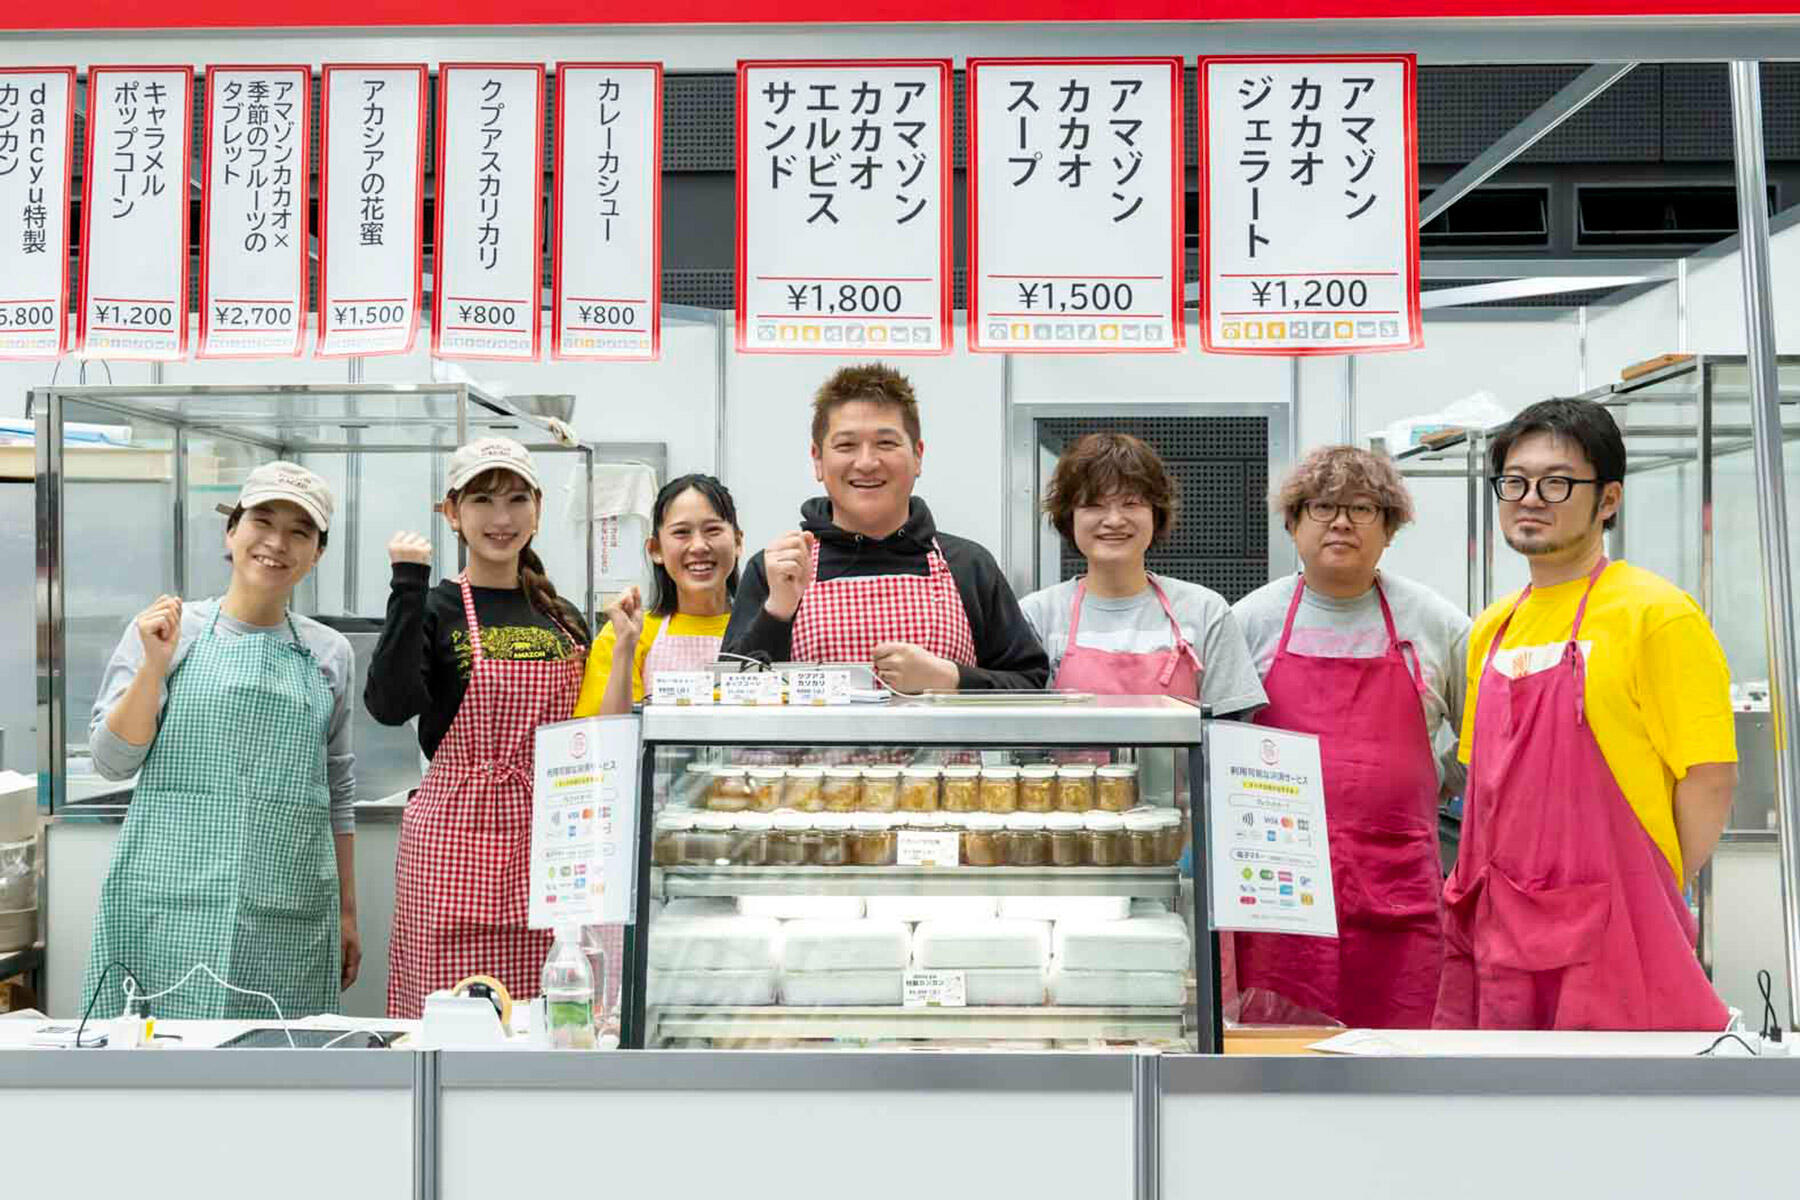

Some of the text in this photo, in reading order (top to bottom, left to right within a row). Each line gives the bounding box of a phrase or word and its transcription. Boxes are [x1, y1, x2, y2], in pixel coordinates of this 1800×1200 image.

[22, 82, 47, 254] dancyu特製
[112, 81, 140, 219] ポップコーン
[142, 81, 166, 196] キャラメル
[222, 81, 243, 186] タブレット
[243, 80, 270, 253] 季節のフルーツの
[360, 80, 386, 246] アカシアの花蜜
[478, 79, 504, 270] クプァスカリカリ
[597, 77, 621, 241] カレーカシュー
[762, 81, 797, 189] サンド
[806, 83, 839, 224] エルビス
[850, 81, 883, 190] カカオ
[893, 81, 927, 225] アマゾン
[1007, 80, 1043, 187] スープ
[1058, 79, 1092, 188] カカオ
[1109, 79, 1144, 223] アマゾン
[1238, 75, 1273, 258] ジェラート
[1290, 76, 1324, 186] カカオ
[1341, 77, 1377, 220] アマゾン
[96, 304, 173, 326] ¥1,200
[215, 306, 292, 326] ¥2,700
[334, 304, 404, 325] ¥1,500
[459, 305, 515, 325] ¥800
[579, 305, 635, 325] ¥800
[787, 284, 902, 313] ¥1,800
[1018, 282, 1133, 312] ¥1,500
[1250, 280, 1368, 309] ¥1,200
